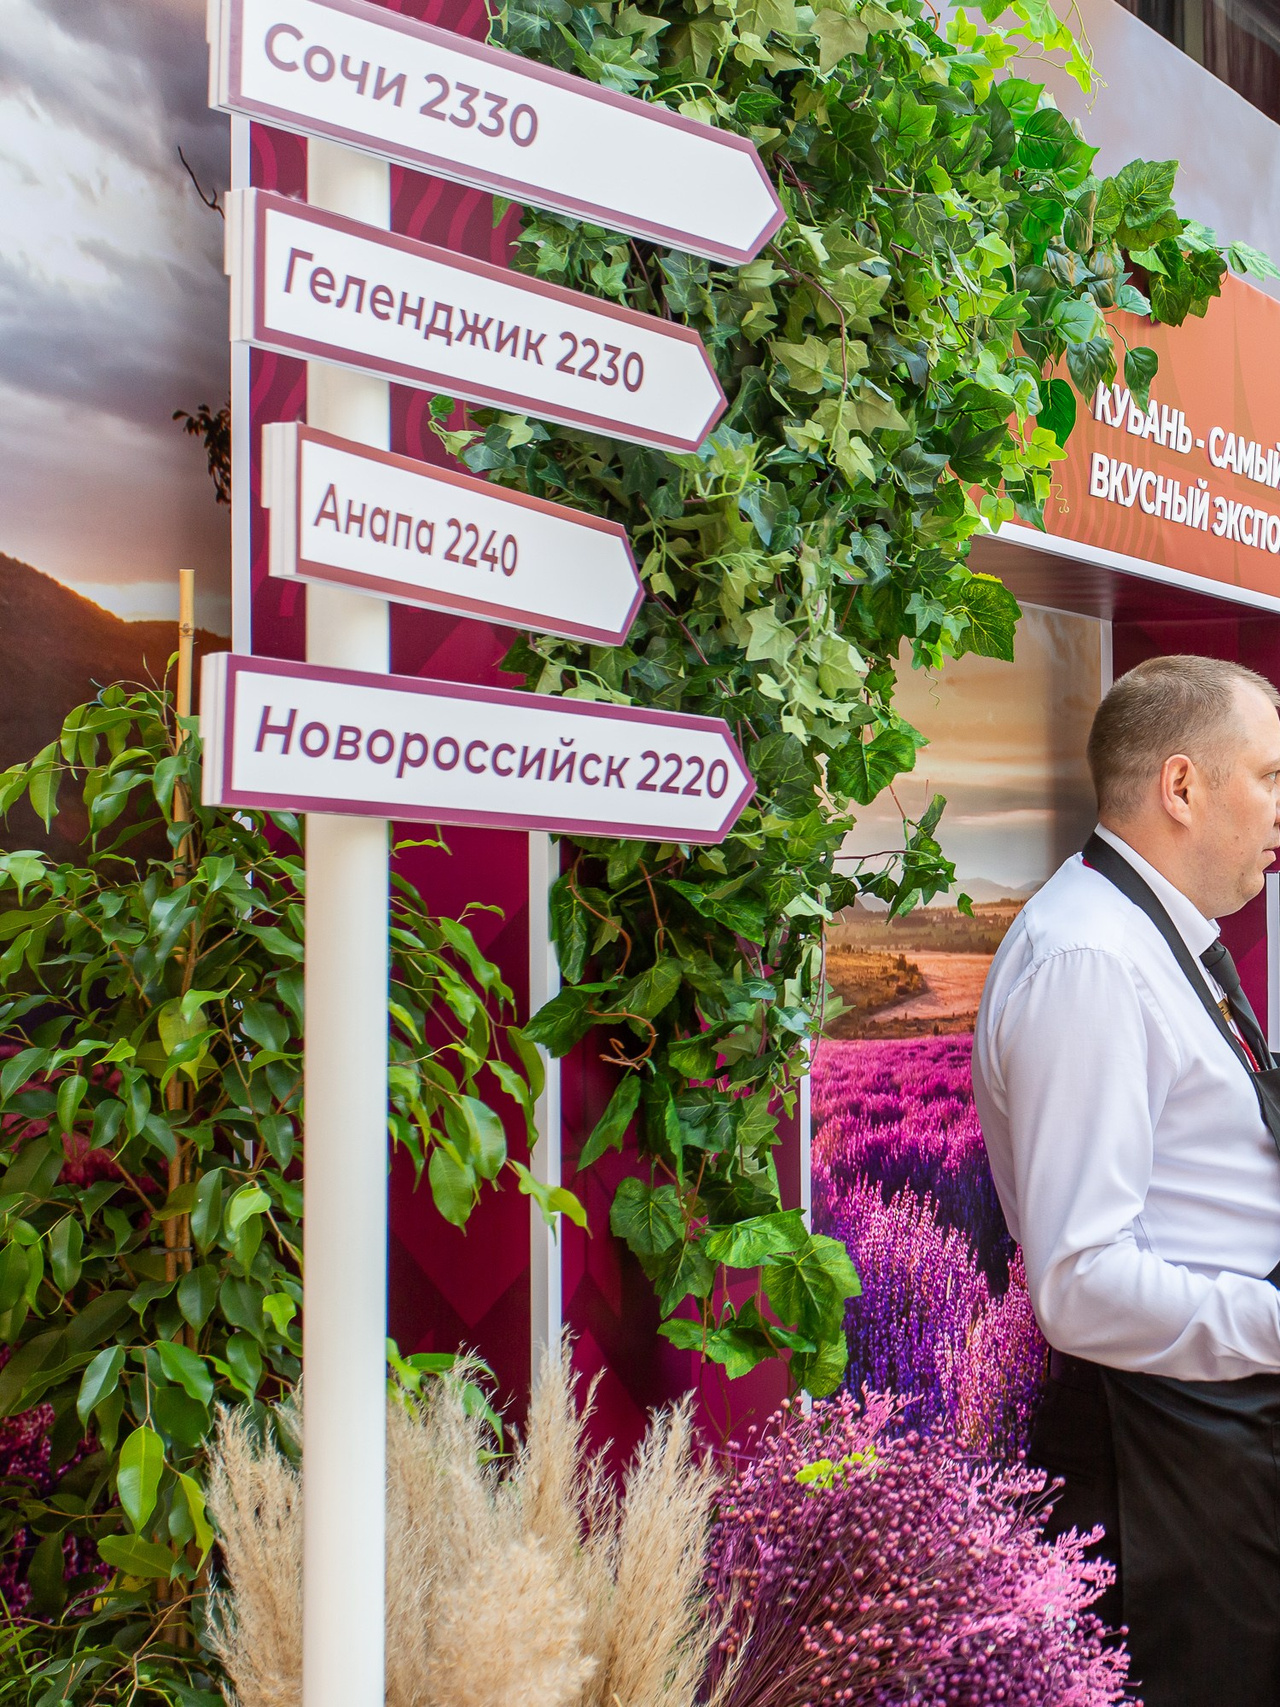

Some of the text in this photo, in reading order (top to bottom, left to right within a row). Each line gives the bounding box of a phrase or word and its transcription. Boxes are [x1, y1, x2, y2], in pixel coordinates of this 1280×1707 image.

[264, 23, 539, 148] Сочи 2330
[283, 247, 645, 393] Геленджик 2230
[313, 483, 519, 578] Анапа 2240
[1089, 451, 1210, 531] ВКУСНЫЙ
[254, 704, 729, 799] Новороссийск 2220
